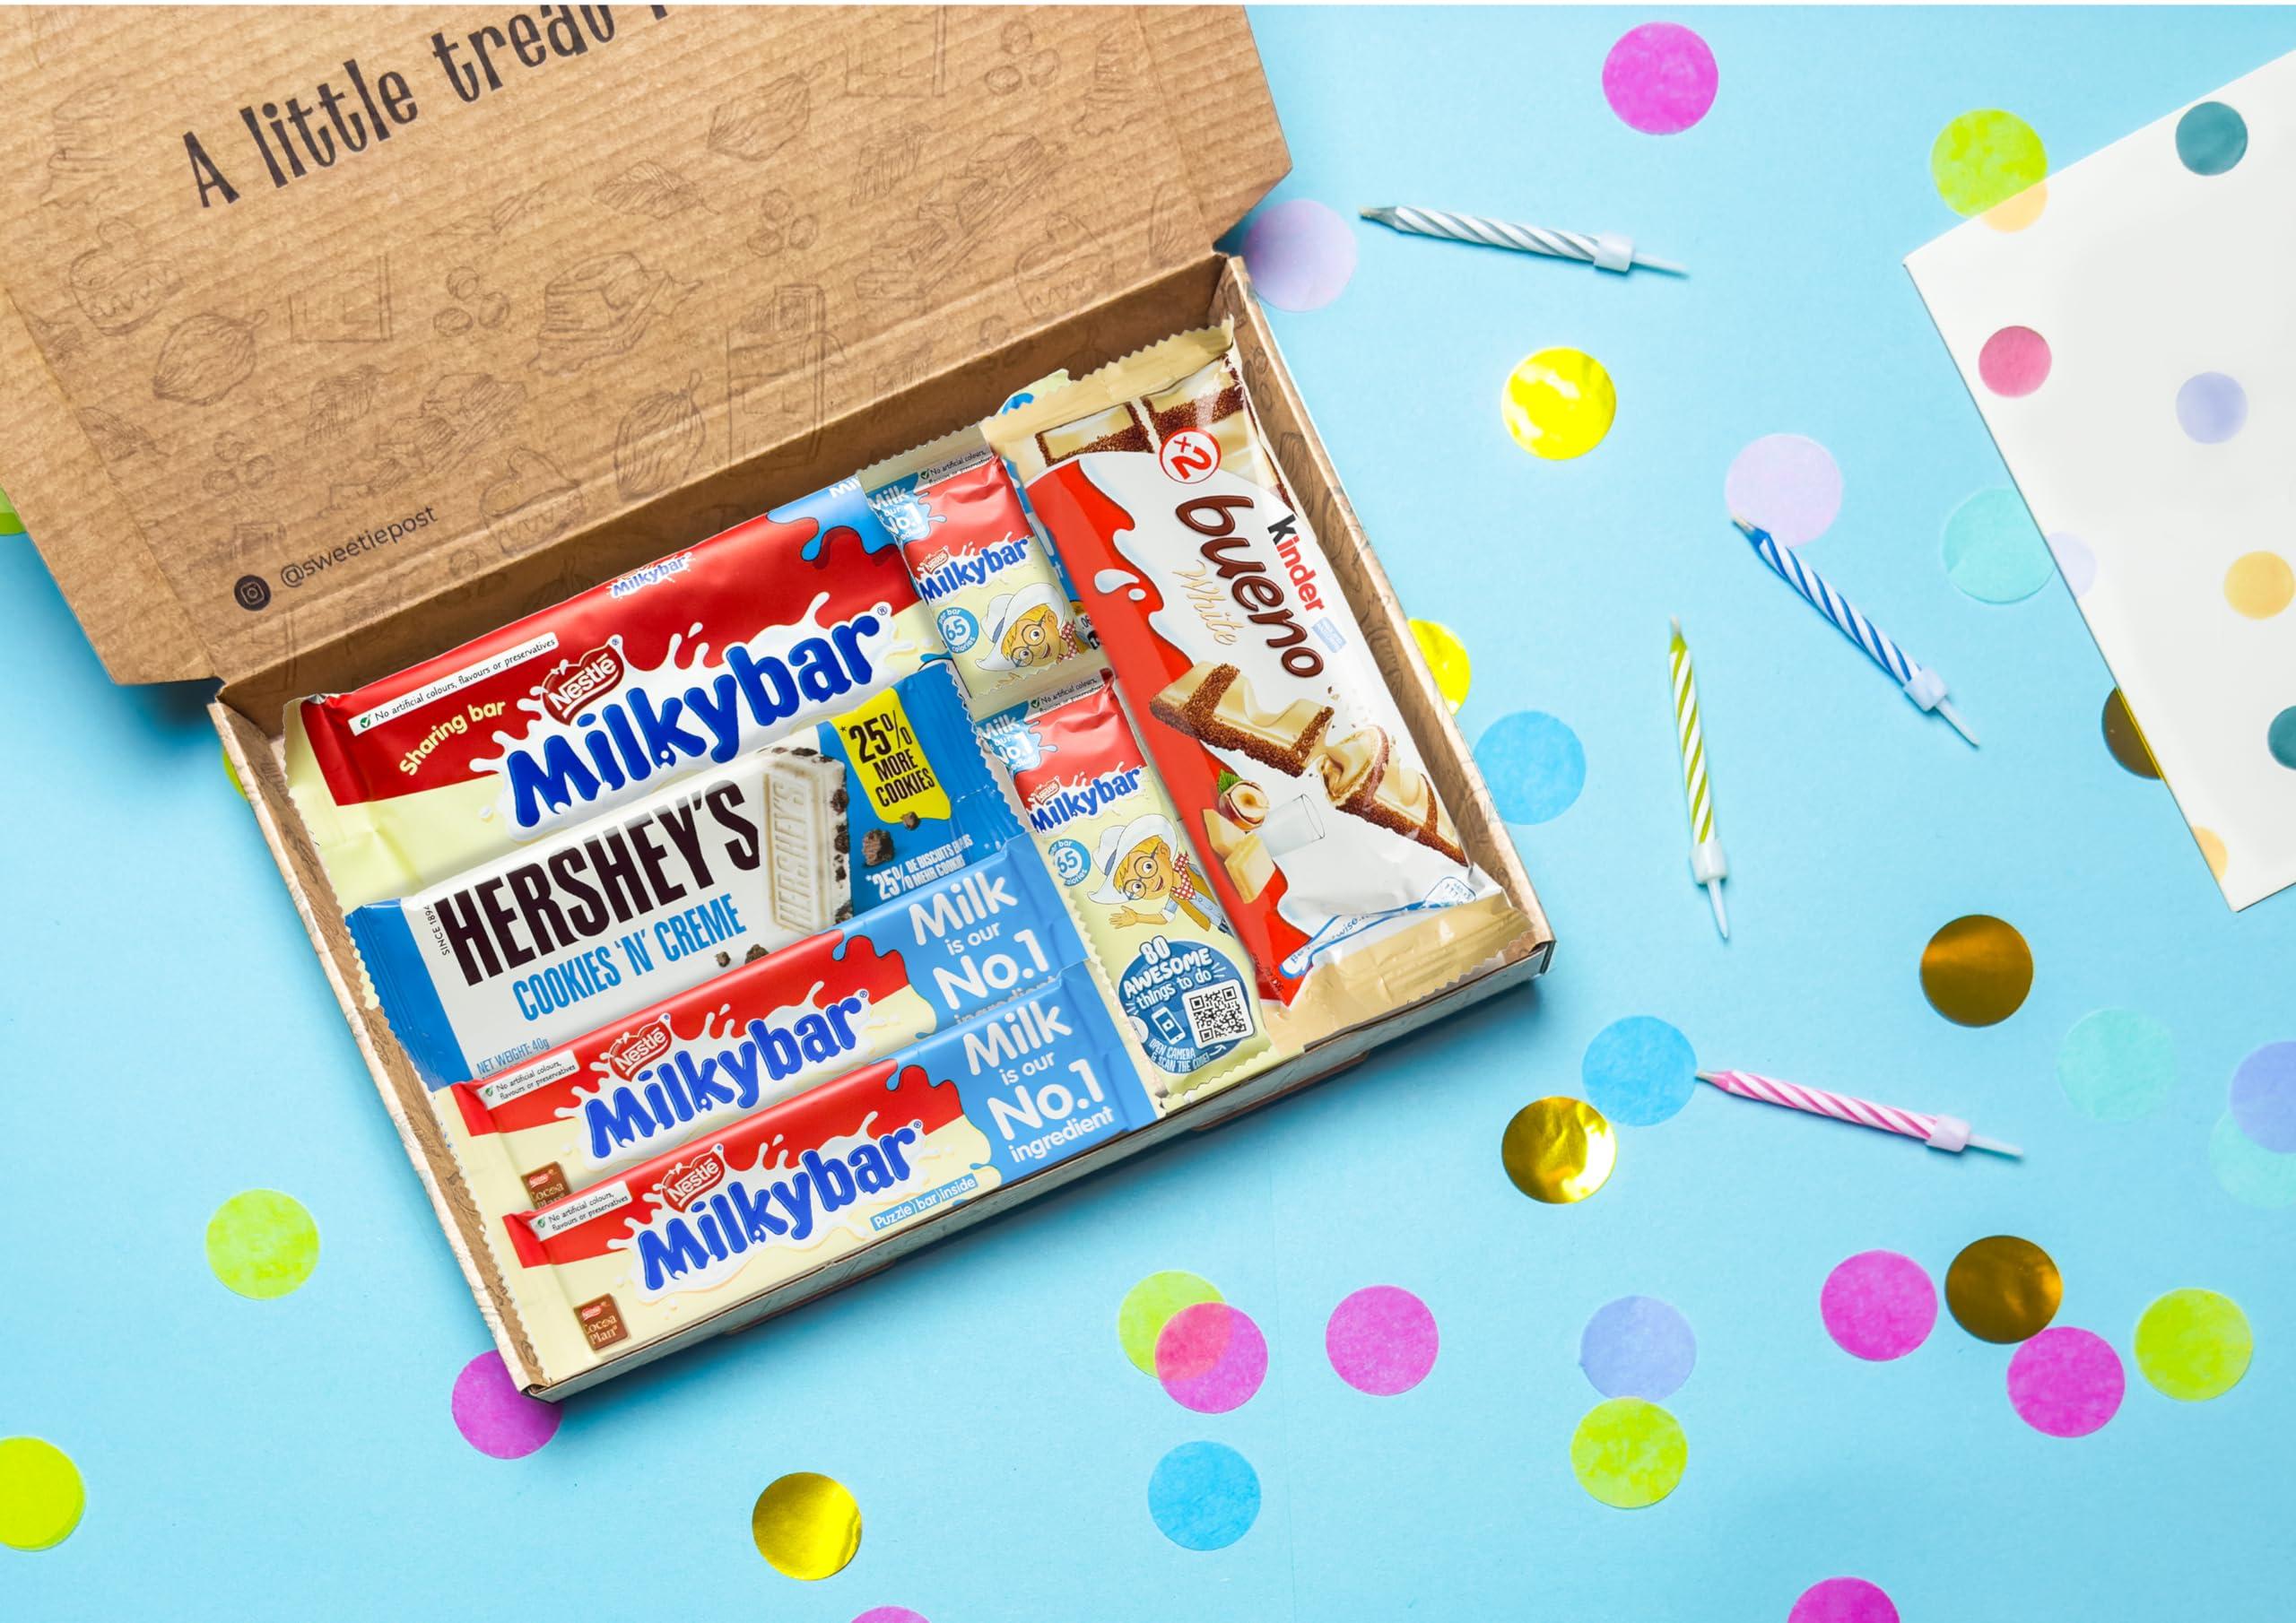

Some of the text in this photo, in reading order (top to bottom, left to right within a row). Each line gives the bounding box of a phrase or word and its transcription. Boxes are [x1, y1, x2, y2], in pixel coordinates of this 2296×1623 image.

[183, 131, 240, 208] A
[239, 58, 418, 188] little
[929, 467, 941, 476] No
[280, 505, 439, 588] @sweetiepost
[611, 554, 687, 598] Milkybar
[918, 538, 1028, 603] Milkybar
[1175, 495, 1324, 678] bueno
[1172, 559, 1244, 646] White
[946, 619, 966, 640] 65
[375, 638, 555, 722] No artificial colours, flavours or preservatives
[547, 653, 617, 711] Nestlé
[399, 699, 506, 776] sharing bar
[507, 615, 880, 828] Milkybar
[873, 749, 918, 782] MORE
[875, 768, 935, 807] COOKIES
[1031, 768, 1140, 833] Milkybar
[917, 844, 954, 869] BISCUITS
[1058, 851, 1078, 873] 65
[434, 780, 761, 986] HERSHEY'S
[909, 872, 1019, 946] Milk
[432, 926, 450, 956] SINCE
[512, 944, 622, 1022] COOKIES
[654, 893, 746, 963] CREME
[944, 922, 1001, 956] is our
[1142, 936, 1170, 965] 80
[932, 929, 1049, 1010] No.1
[1124, 948, 1213, 999] AWESOME
[1136, 968, 1212, 1010] things to do
[476, 1059, 493, 1074] NET
[495, 1044, 531, 1067] WEIGHT:
[532, 1037, 550, 1055] 40g
[615, 1028, 666, 1072] Nestlé
[962, 1001, 1073, 1076] Milk
[1149, 1038, 1196, 1060] OPEN CAMERA
[496, 1083, 508, 1092] No
[509, 1071, 535, 1089] artificial
[500, 1087, 526, 1100] flavours
[535, 1064, 576, 1087] preservatives
[586, 997, 862, 1159] Milkybar
[999, 1052, 1054, 1085] is our
[1158, 1055, 1177, 1072] SCAN
[1177, 1060, 1192, 1072] THE
[987, 1058, 1104, 1141] No.1
[1008, 1106, 1115, 1163] ingredient
[668, 1159, 719, 1204] Nestlé
[874, 1178, 976, 1228] Puzzle bar inside
[548, 1214, 561, 1223] No
[561, 1202, 587, 1218] artificial
[552, 1218, 578, 1231] flavours
[588, 1195, 629, 1218] preservatives
[638, 1128, 916, 1290] Milkybar
[589, 1327, 616, 1345] Plan
